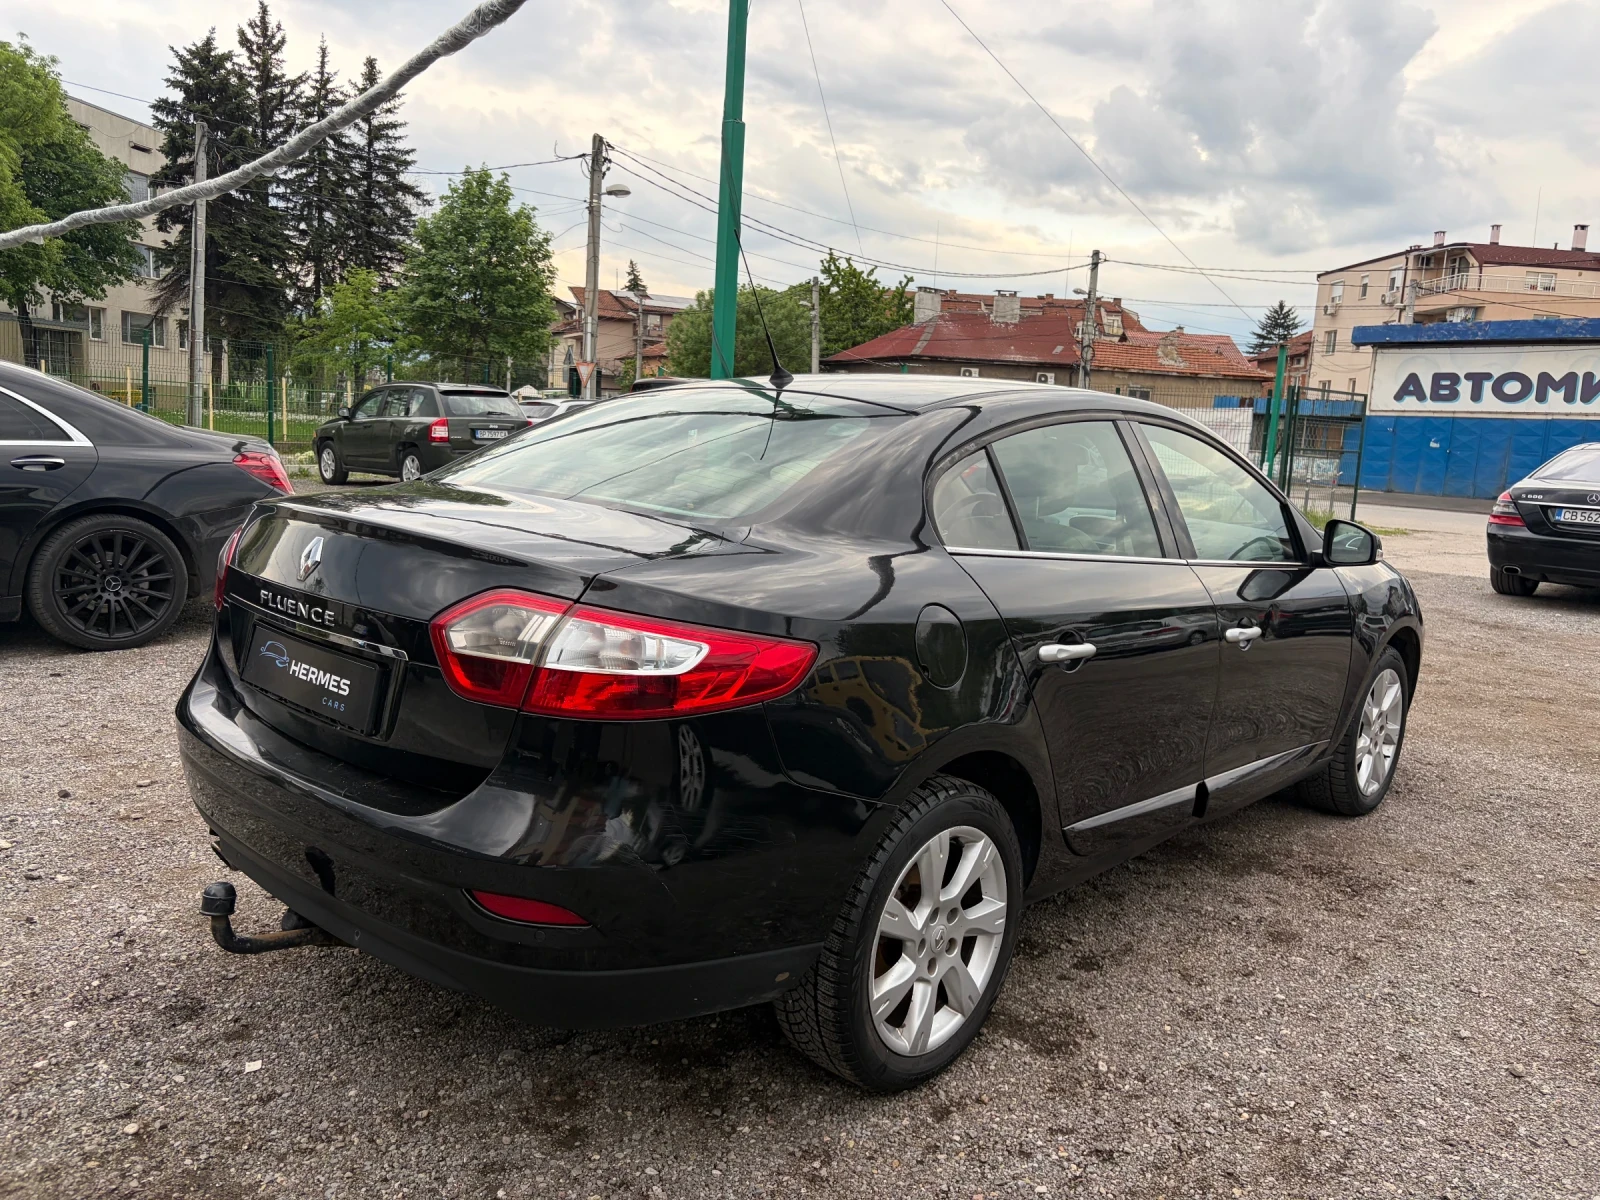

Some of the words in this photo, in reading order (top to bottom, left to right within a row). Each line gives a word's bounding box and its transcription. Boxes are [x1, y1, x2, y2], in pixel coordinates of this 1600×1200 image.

[1563, 510, 1578, 521] CB
[1579, 511, 1600, 522] 562
[260, 589, 335, 627] FLUENCE
[289, 660, 351, 696] HERMES
[322, 697, 345, 712] CARS
